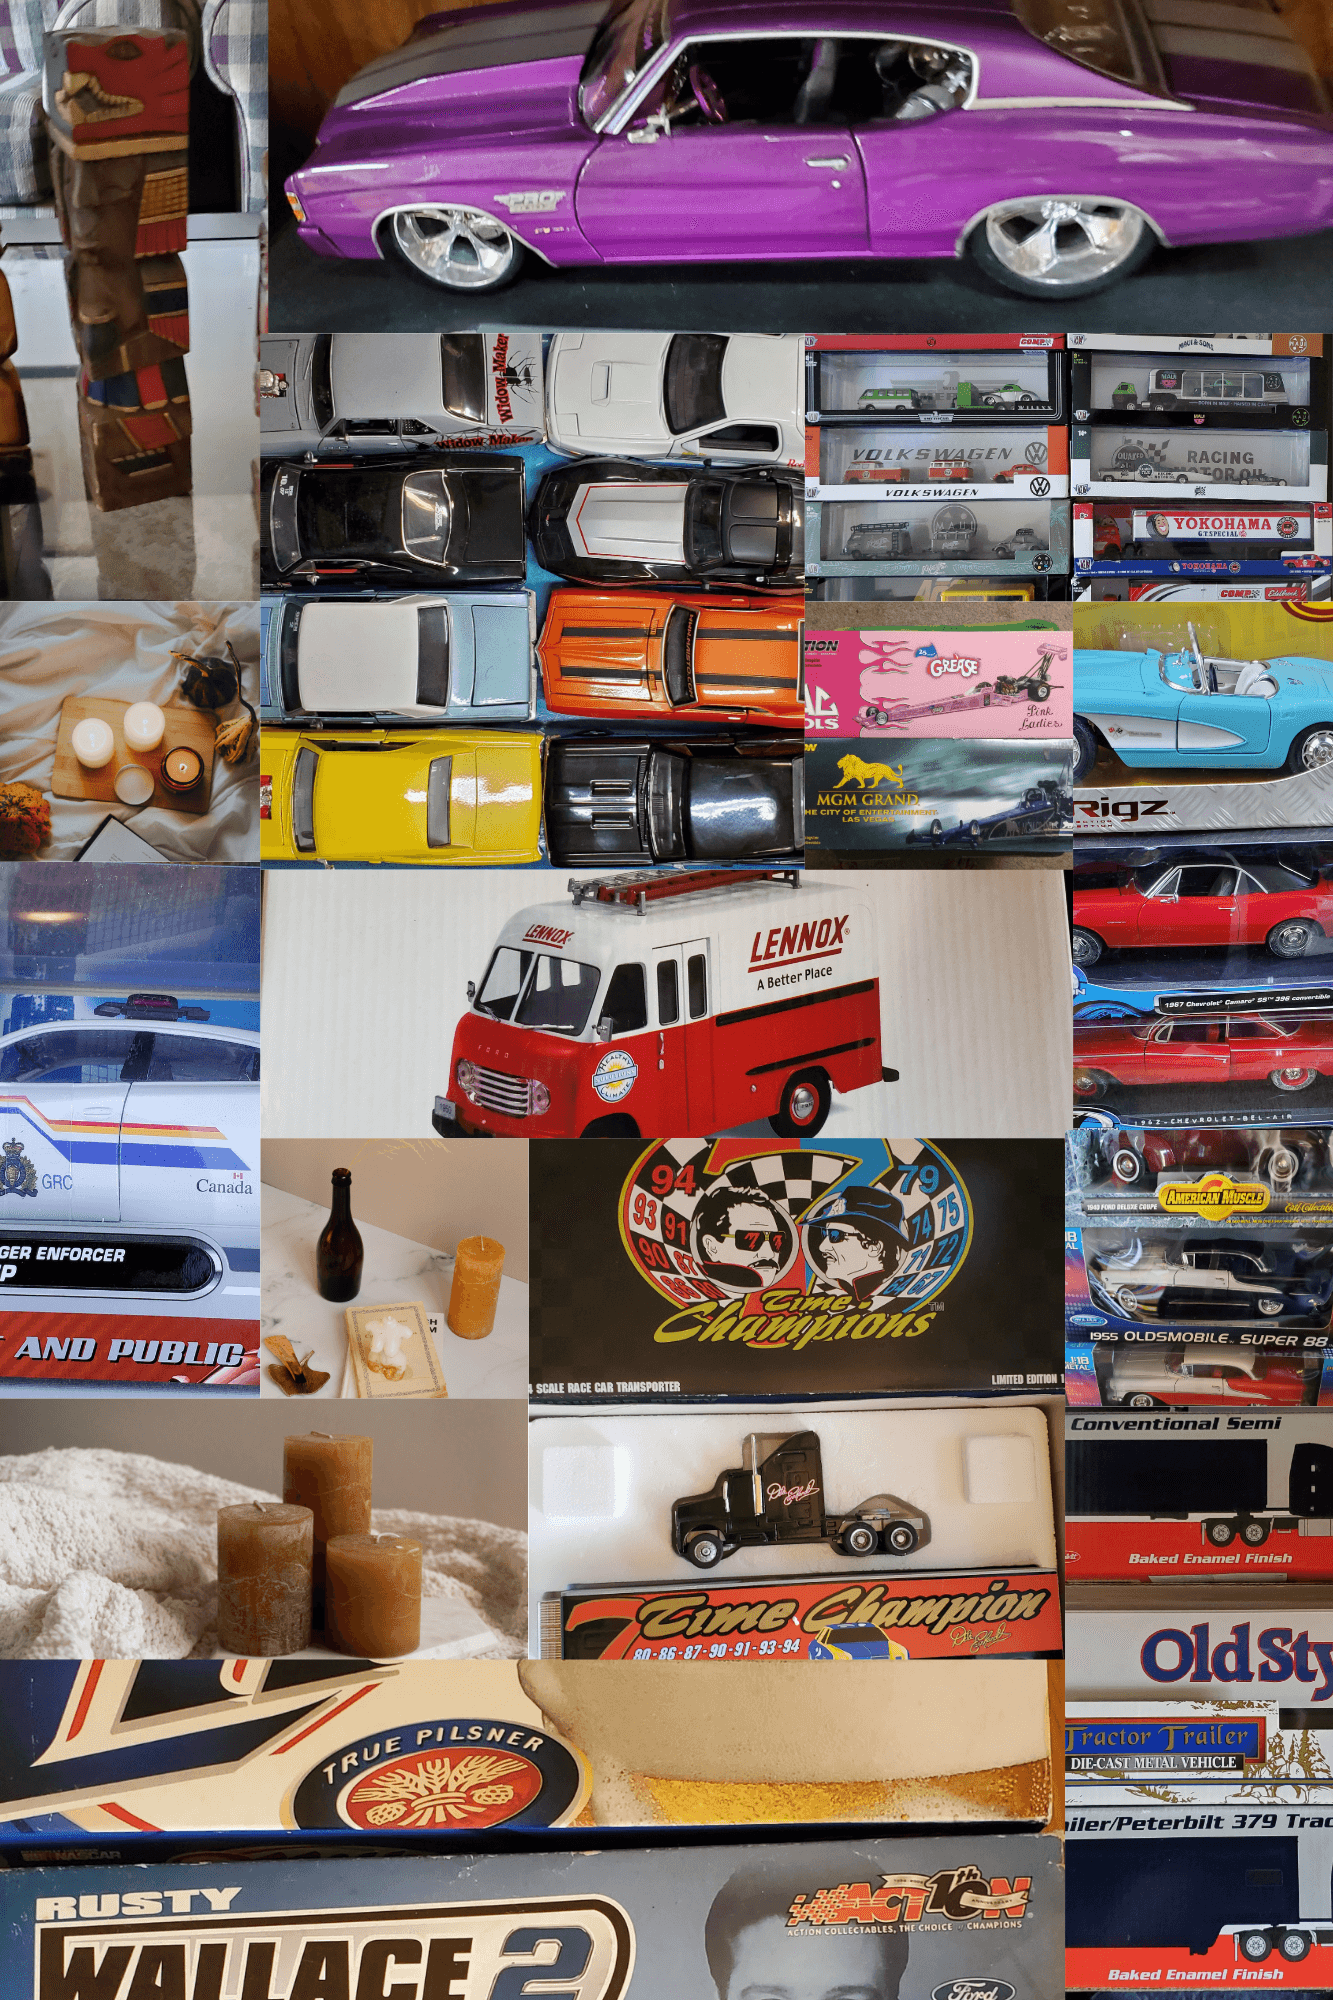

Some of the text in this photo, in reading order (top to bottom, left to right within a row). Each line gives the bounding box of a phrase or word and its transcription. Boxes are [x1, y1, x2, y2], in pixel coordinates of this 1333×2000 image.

[492, 333, 509, 373] Maker
[495, 376, 514, 424] Widow
[434, 437, 484, 449] Widow
[852, 449, 1012, 461] VOLKSWAGEN
[1187, 451, 1254, 464] RACING
[885, 488, 979, 497] VOLKSWAGEN
[1174, 518, 1272, 530] YOKOHAMA
[1221, 590, 1251, 598] COMP
[930, 658, 978, 677] GREASE
[1027, 704, 1054, 717] Pink
[1018, 718, 1063, 731] Ladies
[817, 794, 919, 806] MGM GRAND
[757, 966, 833, 991] A Better Place
[1291, 993, 1330, 1001] convertible
[599, 1054, 631, 1071] HEALTHY
[601, 1081, 630, 1098] CLIMATE
[42, 1174, 73, 1190] GRC
[196, 1179, 253, 1195] Canada
[651, 1165, 696, 1195] 94
[898, 1165, 939, 1194] 79
[1166, 1189, 1265, 1206] AMERICAN MUSCLE
[633, 1193, 657, 1230] 93
[937, 1192, 960, 1232] 75
[1117, 1203, 1138, 1211] DELUXE
[665, 1213, 686, 1245] 91
[912, 1209, 932, 1244] 74
[36, 1247, 126, 1262] ENFORCER
[639, 1237, 670, 1269] 90
[930, 1233, 959, 1267] 72
[673, 1251, 698, 1276] 87
[903, 1245, 931, 1274] 71
[907, 1270, 945, 1295] 67
[760, 1289, 853, 1313] Time
[928, 1302, 944, 1311] TM
[653, 1302, 937, 1350] Champions
[1090, 1331, 1329, 1347] 1955 OLDSMOBILE SUPER 88
[15, 1337, 247, 1366] AND PUBLIC
[536, 1383, 564, 1394] SCALE
[567, 1383, 591, 1393] RACE
[594, 1382, 614, 1392] CAR
[616, 1381, 681, 1392] TRANSPORTER
[991, 1374, 1023, 1385] LIMITED
[1026, 1374, 1057, 1384] EDITION
[1071, 1417, 1282, 1431] Conventional Semi
[1129, 1553, 1293, 1564] Baked Enamel Finish
[565, 1580, 1051, 1660] 7 Time Champion
[1141, 1622, 1255, 1682] Old
[1157, 1725, 1249, 1751] Trailer
[323, 1726, 543, 1784] TRUE PILSNER
[1071, 1756, 1237, 1770] DIE-CAST METAL VEHICLE
[1231, 1814, 1277, 1829] 379
[36, 1887, 243, 1921] RUSTY
[787, 1929, 822, 1937] ACTION
[824, 1926, 897, 1936] COLLECTABLES,
[899, 1924, 916, 1932] THE
[918, 1923, 953, 1932] CHOICE
[966, 1921, 1022, 1930] CHAMPIONS
[71, 1927, 593, 2000] WALLACE 2
[1108, 1968, 1284, 1981] Baked Enamel Finish
[948, 1981, 999, 2000] Ford
